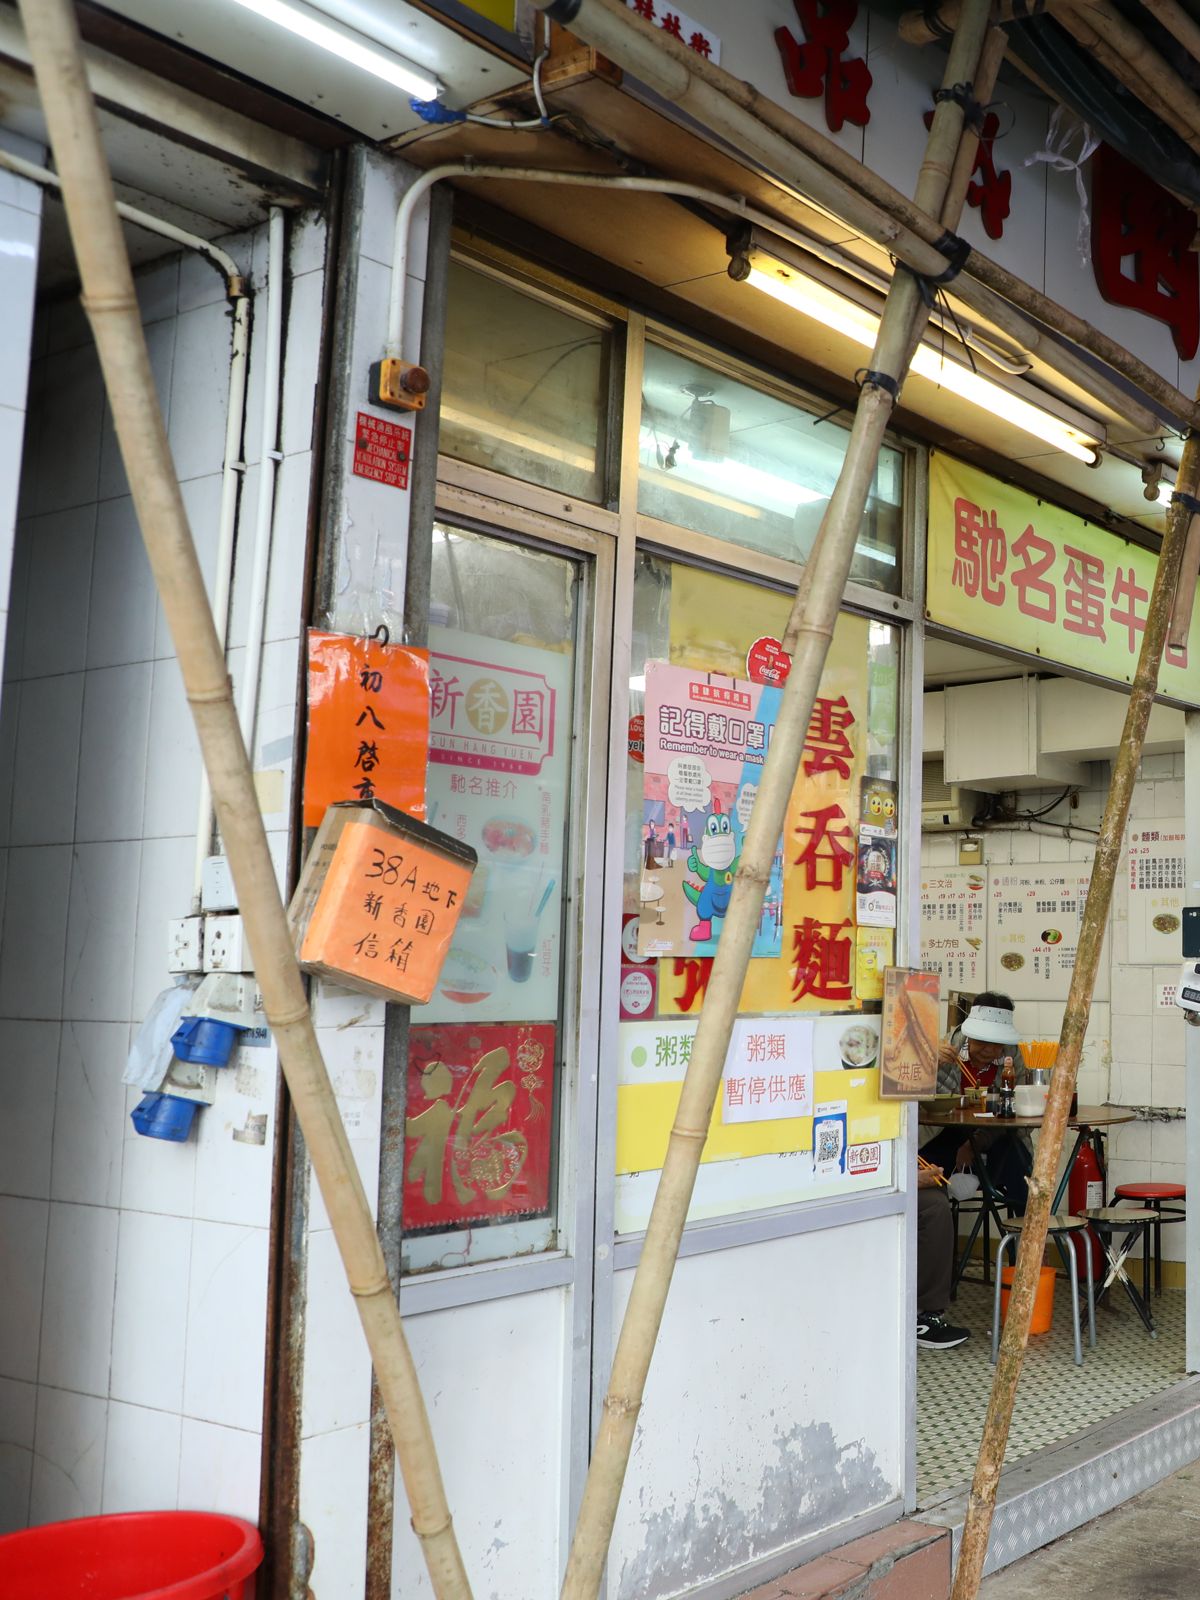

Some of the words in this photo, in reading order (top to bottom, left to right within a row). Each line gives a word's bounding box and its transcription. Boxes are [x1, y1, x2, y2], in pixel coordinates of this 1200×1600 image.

[952, 497, 1187, 669] 馳名蛋牛
[430, 669, 544, 743] 新香園
[431, 733, 455, 748] SUN
[464, 741, 496, 755] HANG
[504, 747, 533, 760] YUEN
[660, 738, 709, 755] Remember
[709, 745, 718, 756] to
[719, 749, 738, 760] wear
[745, 754, 765, 765] mask
[450, 773, 517, 799] 馳名推介
[929, 880, 953, 888] 三文治
[364, 892, 435, 936] 新香園
[353, 931, 413, 973] 信箱
[747, 1033, 786, 1062] 粥類
[898, 1062, 922, 1080] 烘底
[727, 1075, 806, 1106] 暫停供應
